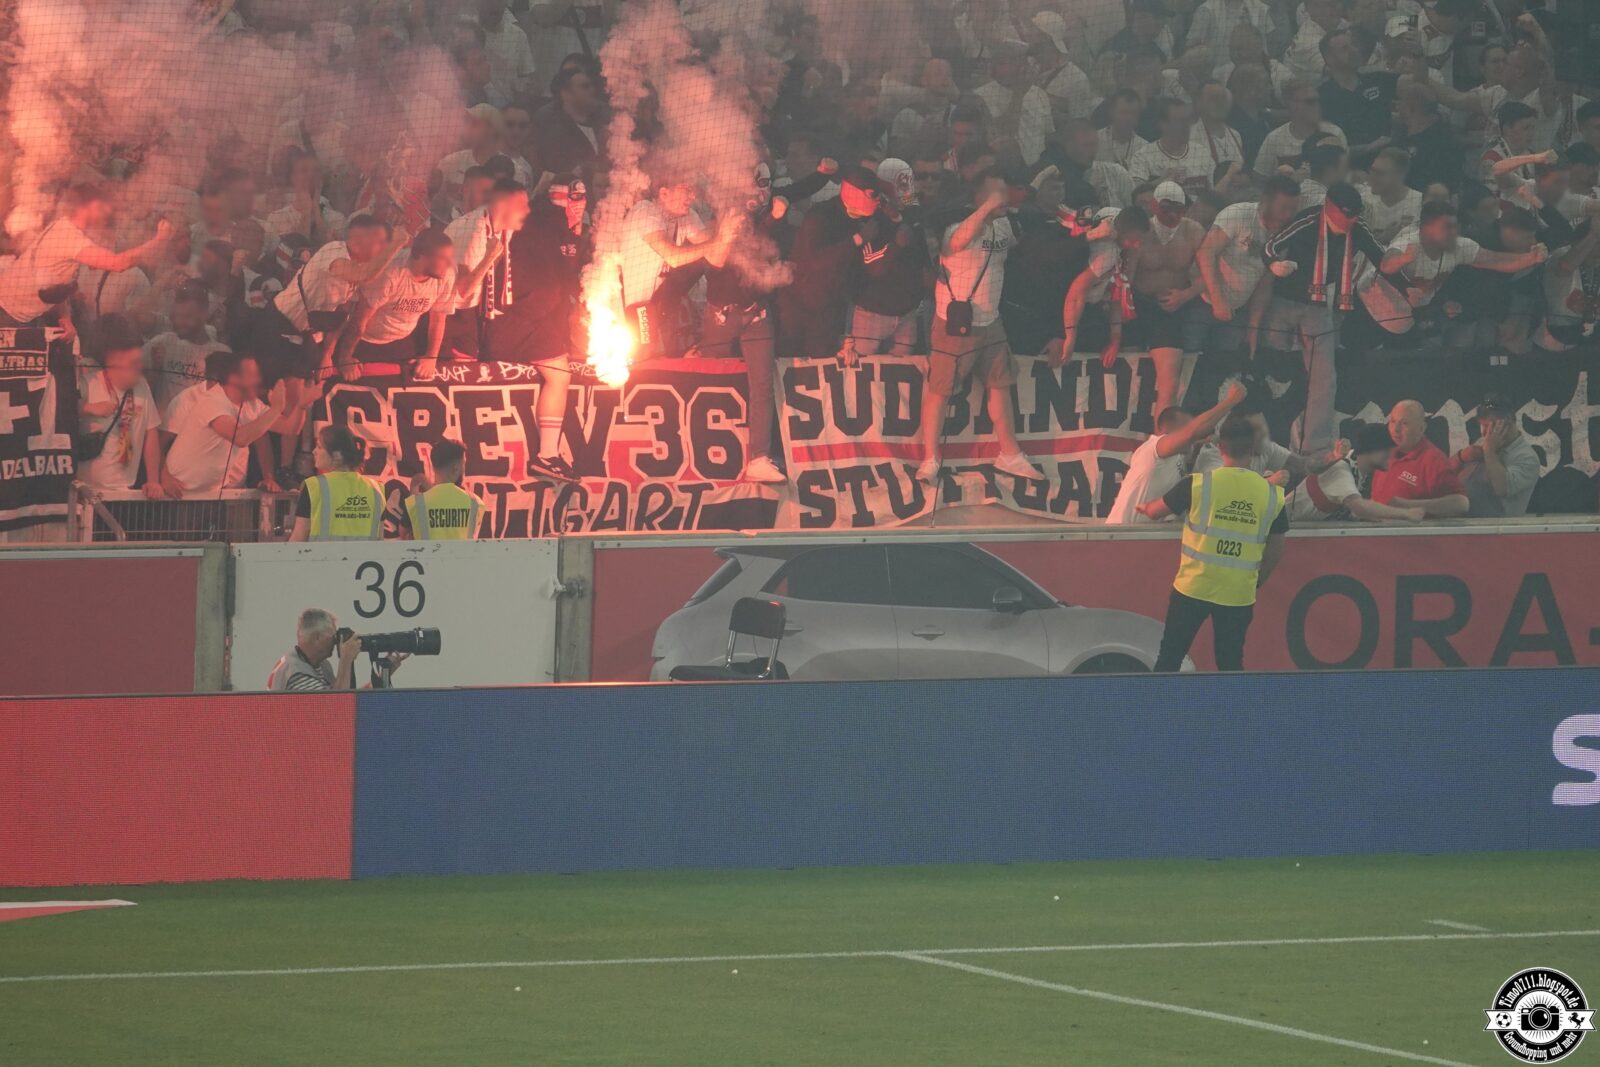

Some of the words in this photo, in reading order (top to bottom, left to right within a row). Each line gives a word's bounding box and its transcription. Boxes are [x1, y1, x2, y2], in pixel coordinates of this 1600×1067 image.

[624, 384, 748, 482] 36
[0, 454, 74, 480] DELBAR
[345, 495, 368, 506] SDS
[796, 456, 1132, 529] STUTTGAR
[383, 477, 715, 540] STTGART
[428, 507, 471, 529] SECURITY
[1230, 500, 1254, 512] SDS
[1216, 539, 1243, 557] 0223
[352, 560, 426, 619] 36
